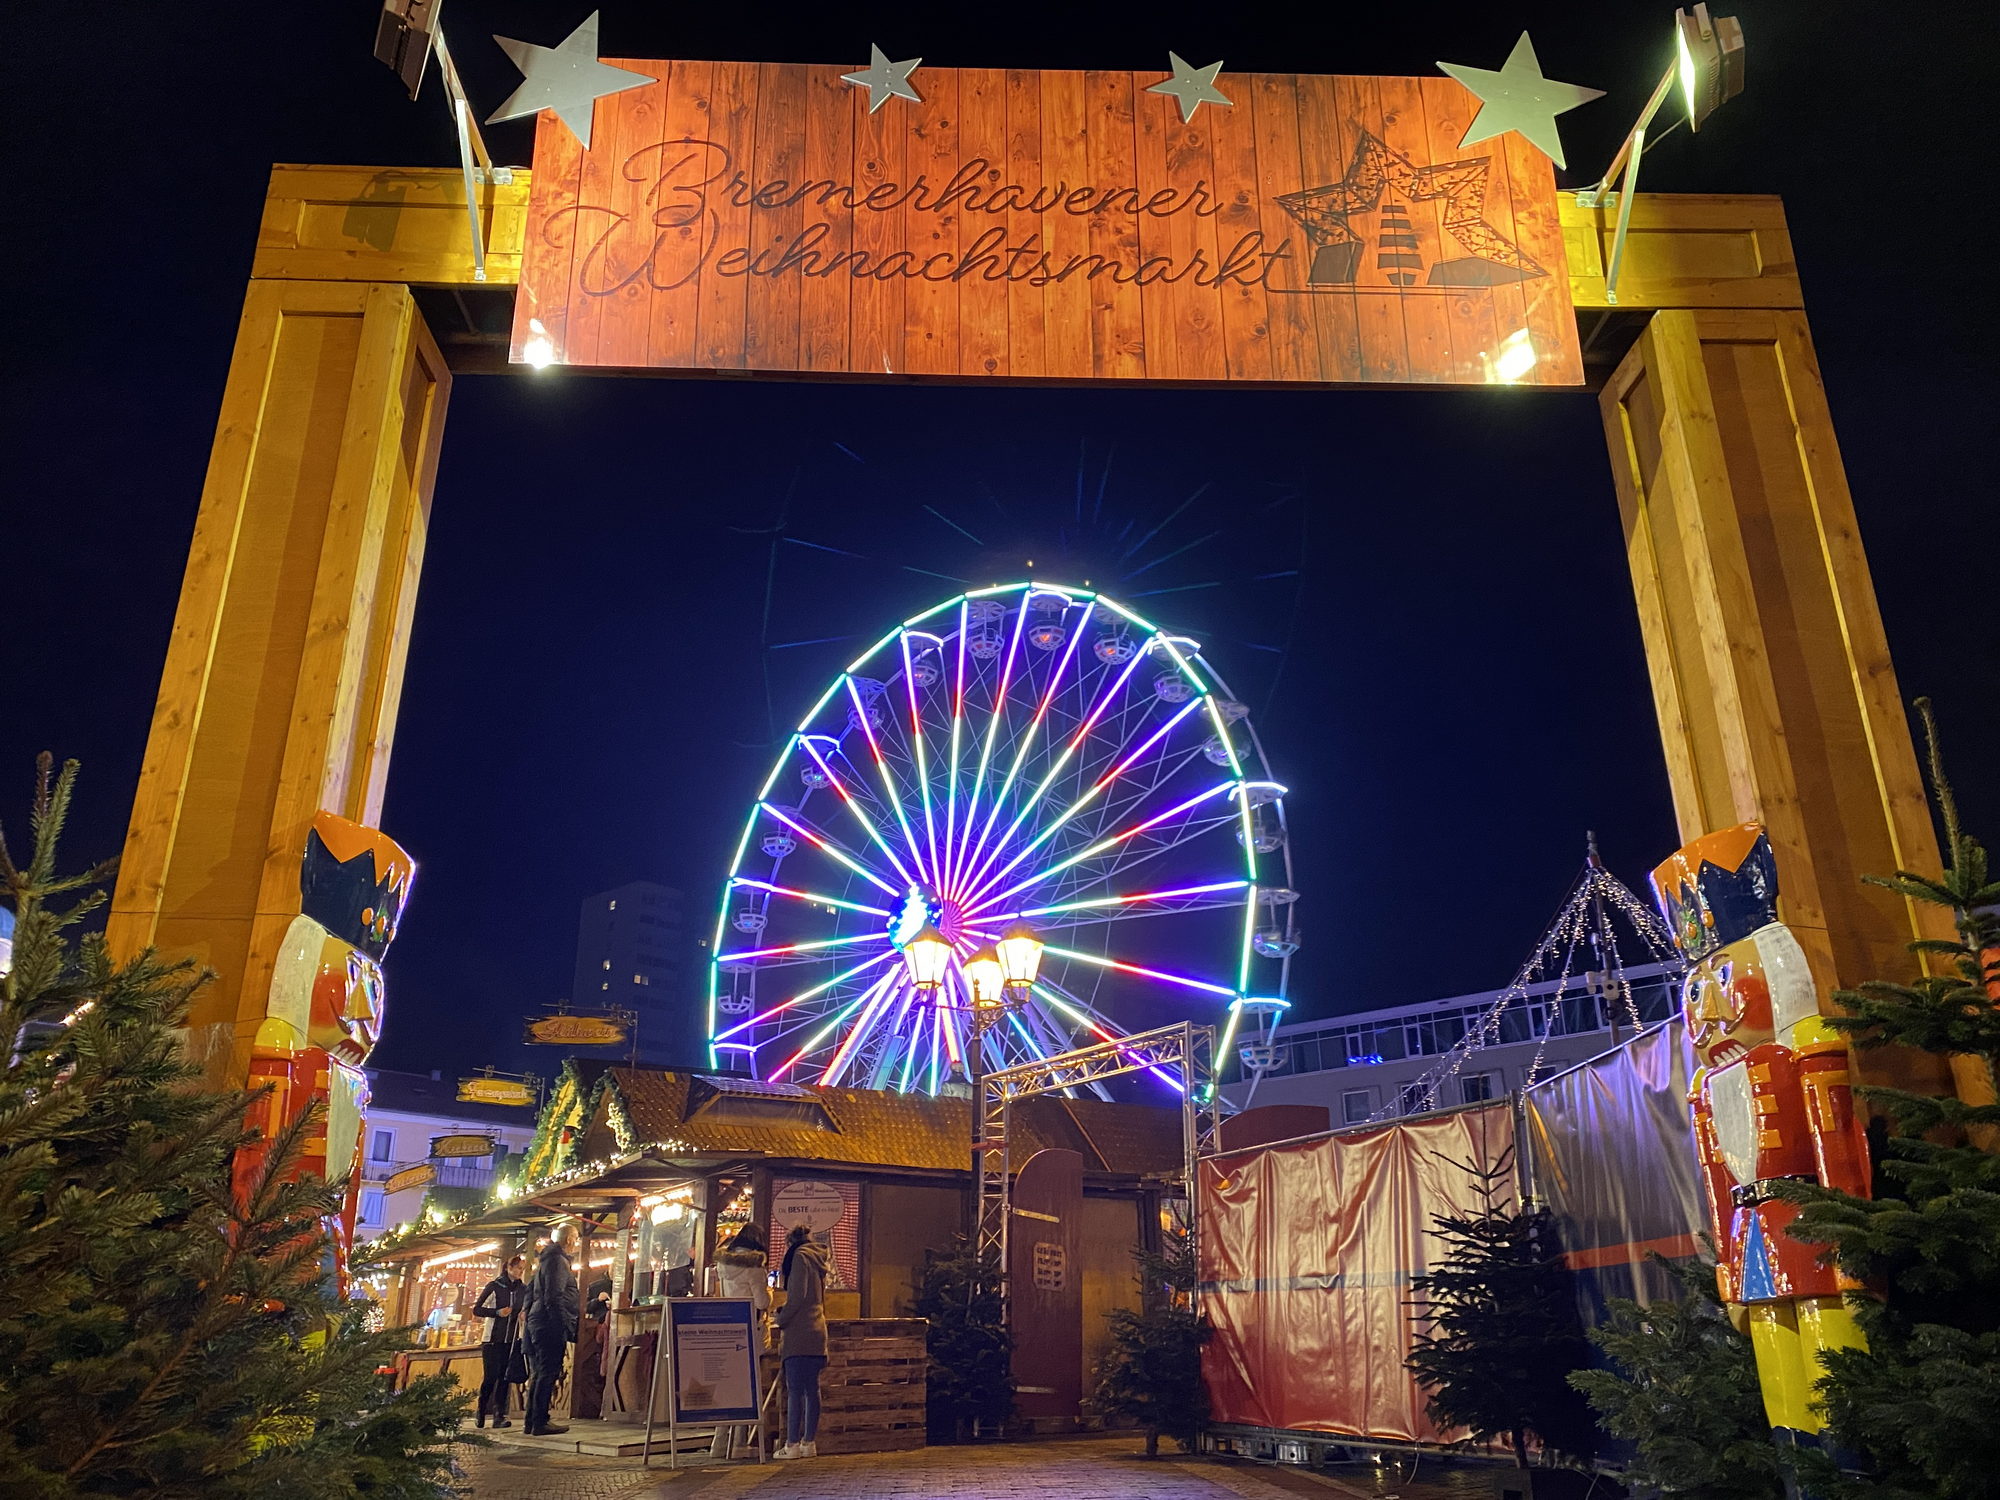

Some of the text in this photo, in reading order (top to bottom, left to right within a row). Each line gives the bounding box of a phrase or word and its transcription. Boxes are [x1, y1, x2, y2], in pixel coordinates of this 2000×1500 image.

[622, 139, 1224, 228] Bremerhavener
[542, 205, 1292, 297] Weihnachtsmarkt
[788, 1206, 809, 1214] BESTE
